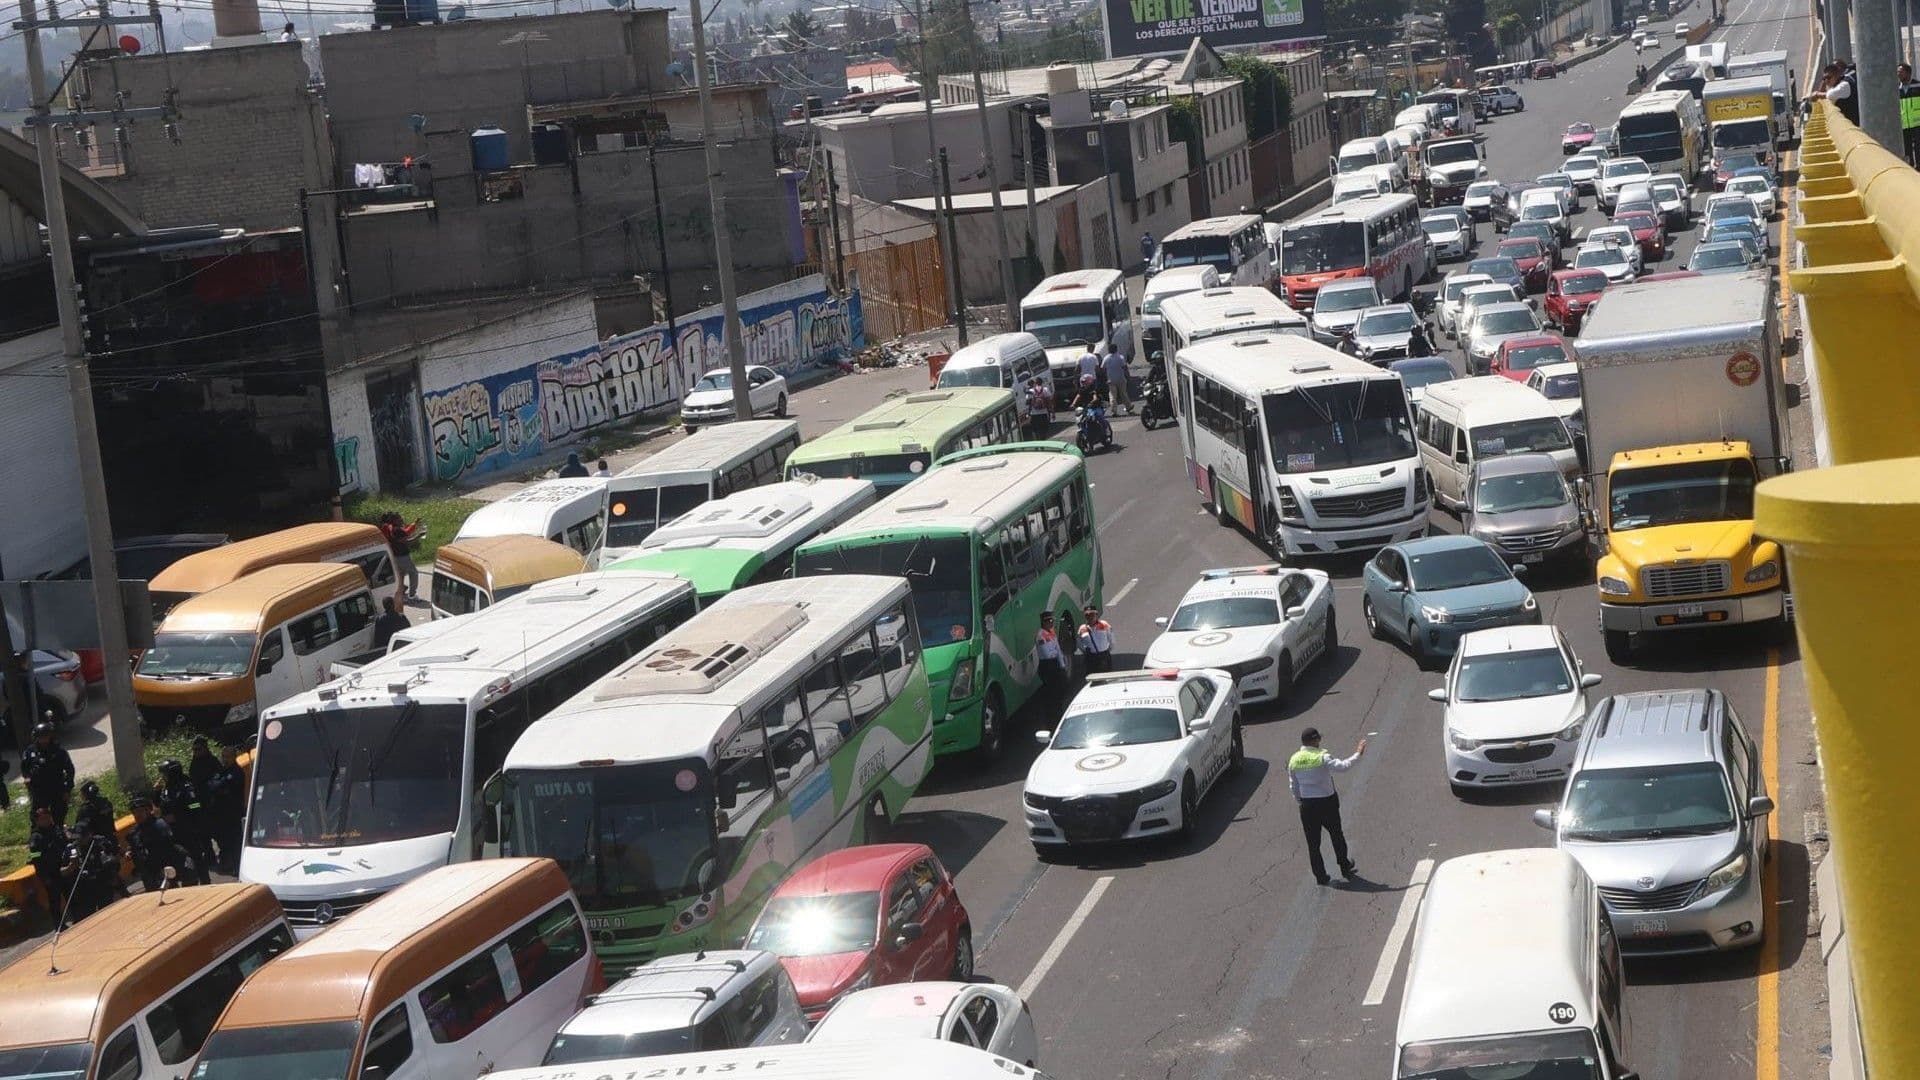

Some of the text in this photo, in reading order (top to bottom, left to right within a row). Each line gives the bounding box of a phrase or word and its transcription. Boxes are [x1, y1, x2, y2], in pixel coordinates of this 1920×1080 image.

[1130, 0, 1167, 23] VER
[1172, 0, 1195, 18] DE
[1266, 12, 1302, 25] VERDE
[1158, 14, 1235, 29] QUE SE RESPETEN
[1135, 20, 1259, 40] LOS DERECHOS DE LA MUJER
[535, 781, 594, 797] RUTA 01
[614, 917, 626, 929] 01
[1550, 1006, 1575, 1020] 190
[755, 1059, 781, 1070] F
